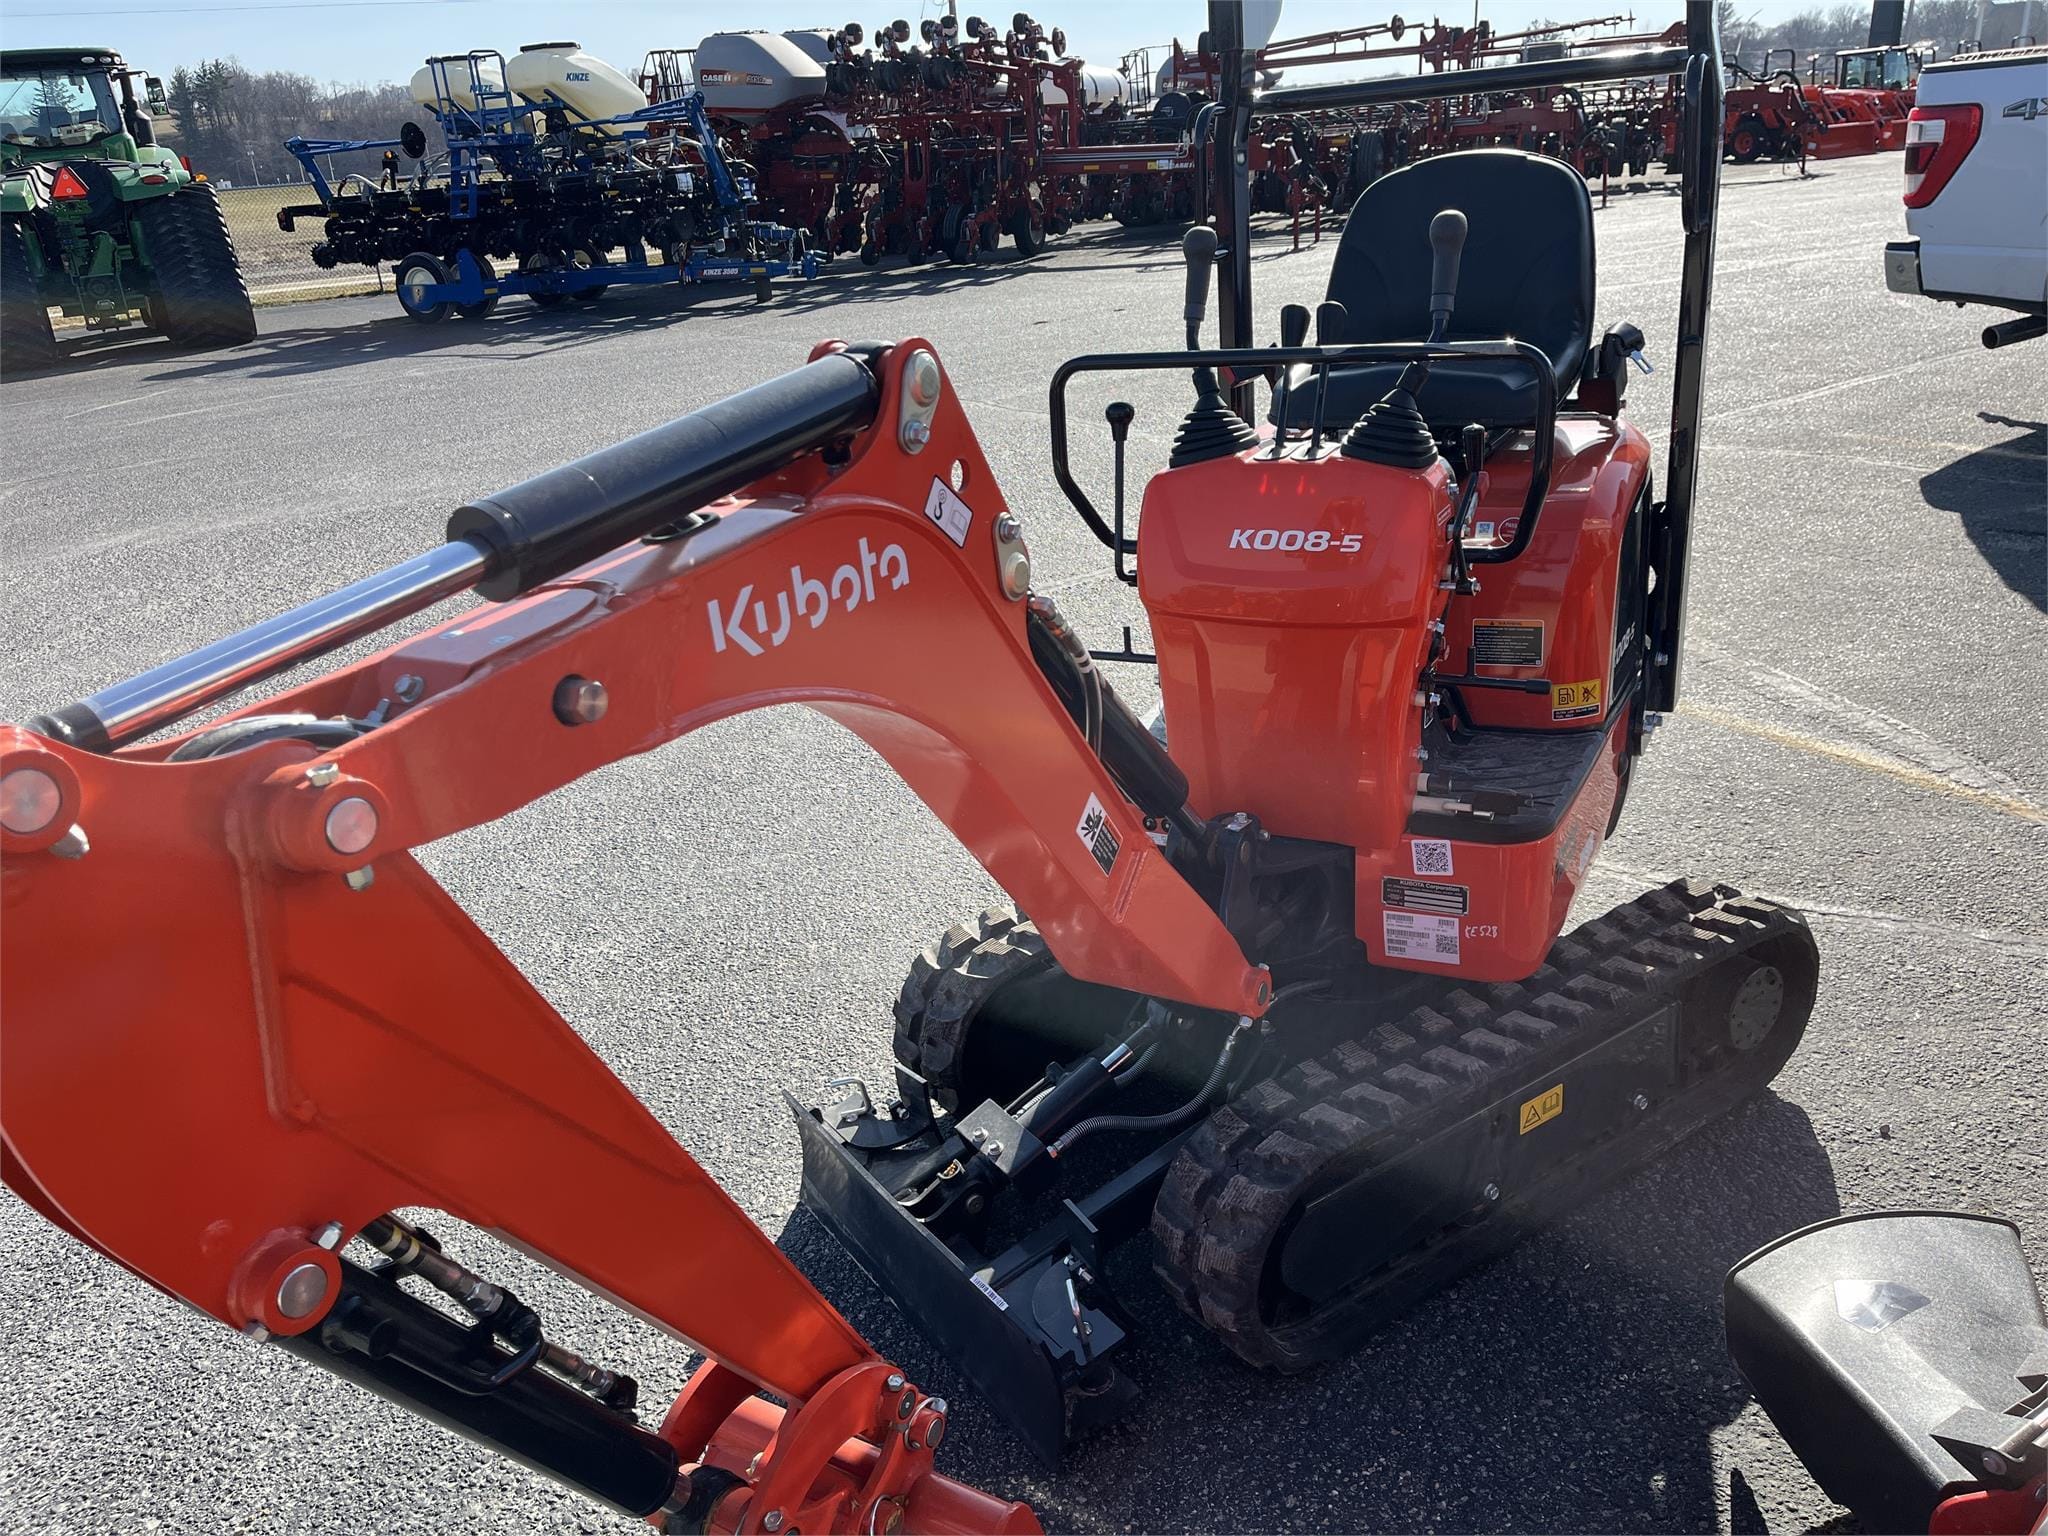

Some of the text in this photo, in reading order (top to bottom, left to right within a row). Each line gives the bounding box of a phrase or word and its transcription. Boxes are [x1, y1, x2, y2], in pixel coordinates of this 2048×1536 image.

[565, 72, 590, 82] KINZE
[702, 74, 723, 82] CASE
[469, 84, 493, 93] KNZE
[1162, 81, 1181, 89] CAE
[703, 268, 722, 276] KINZE
[1229, 528, 1363, 553] K008-5
[706, 536, 910, 657] Kubota
[1399, 880, 1425, 889] KUBOTA
[1425, 884, 1461, 893] Corporation
